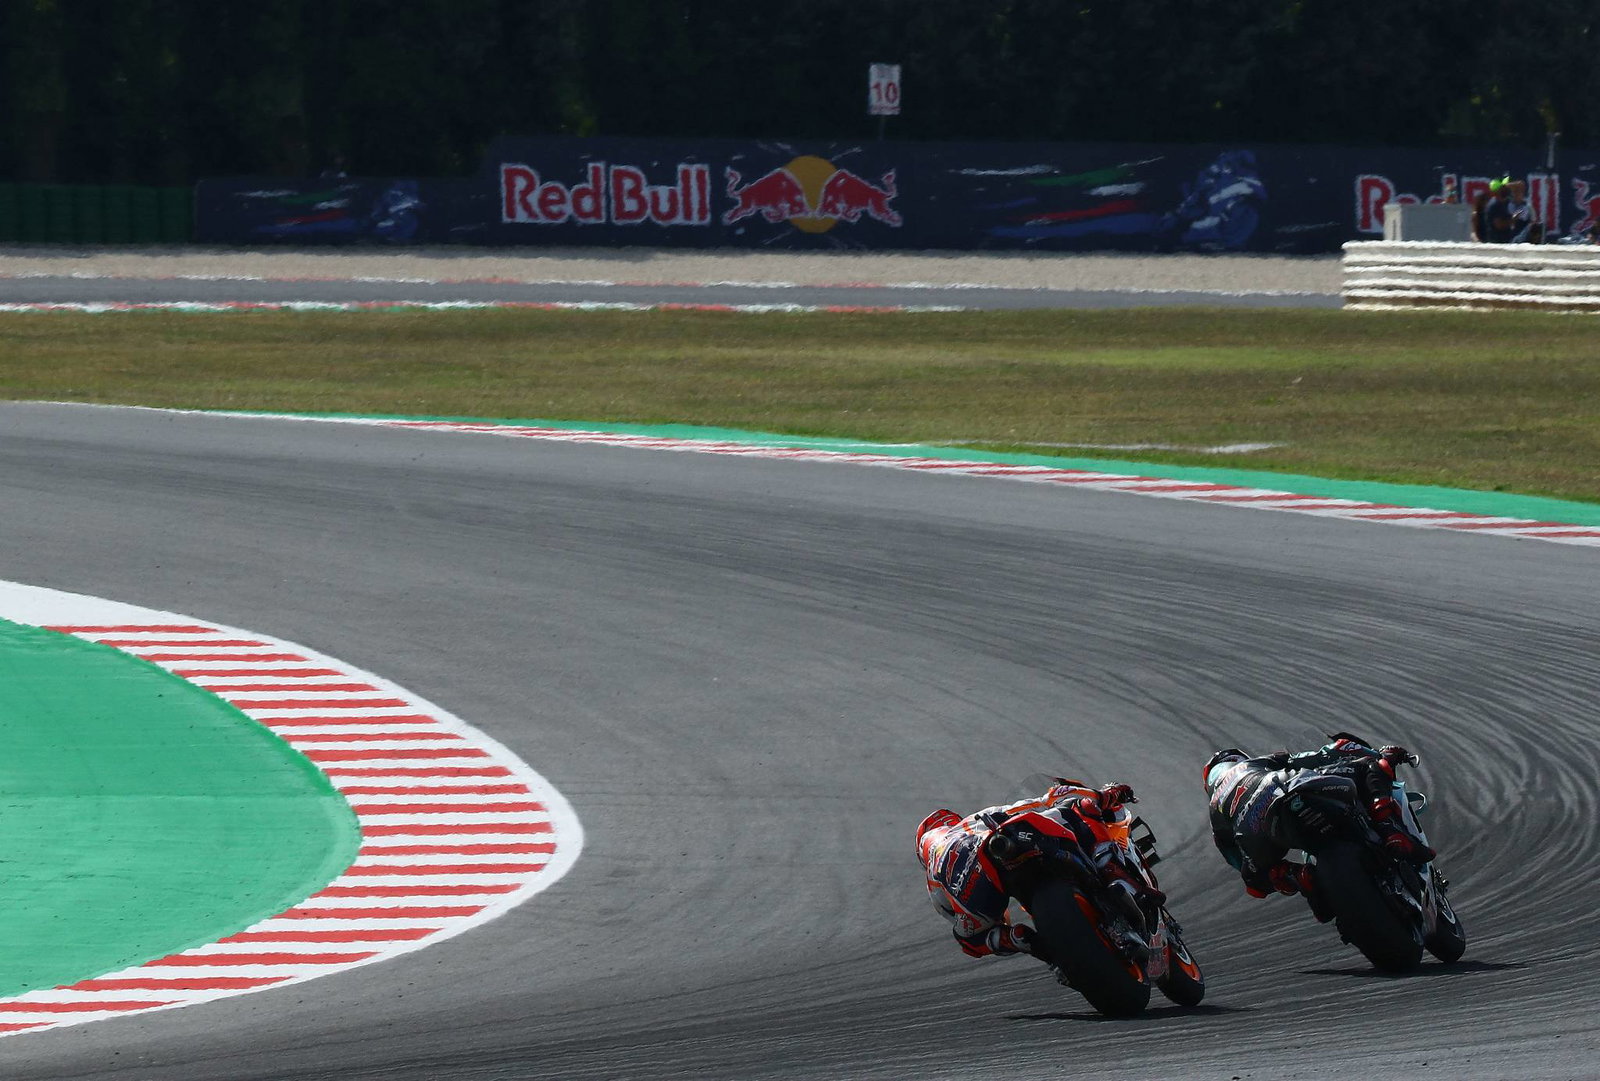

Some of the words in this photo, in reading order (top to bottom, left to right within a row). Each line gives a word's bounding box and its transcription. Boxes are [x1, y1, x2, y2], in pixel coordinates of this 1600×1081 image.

[872, 81, 898, 103] 10
[501, 162, 606, 224] Red
[610, 163, 710, 226] Bull
